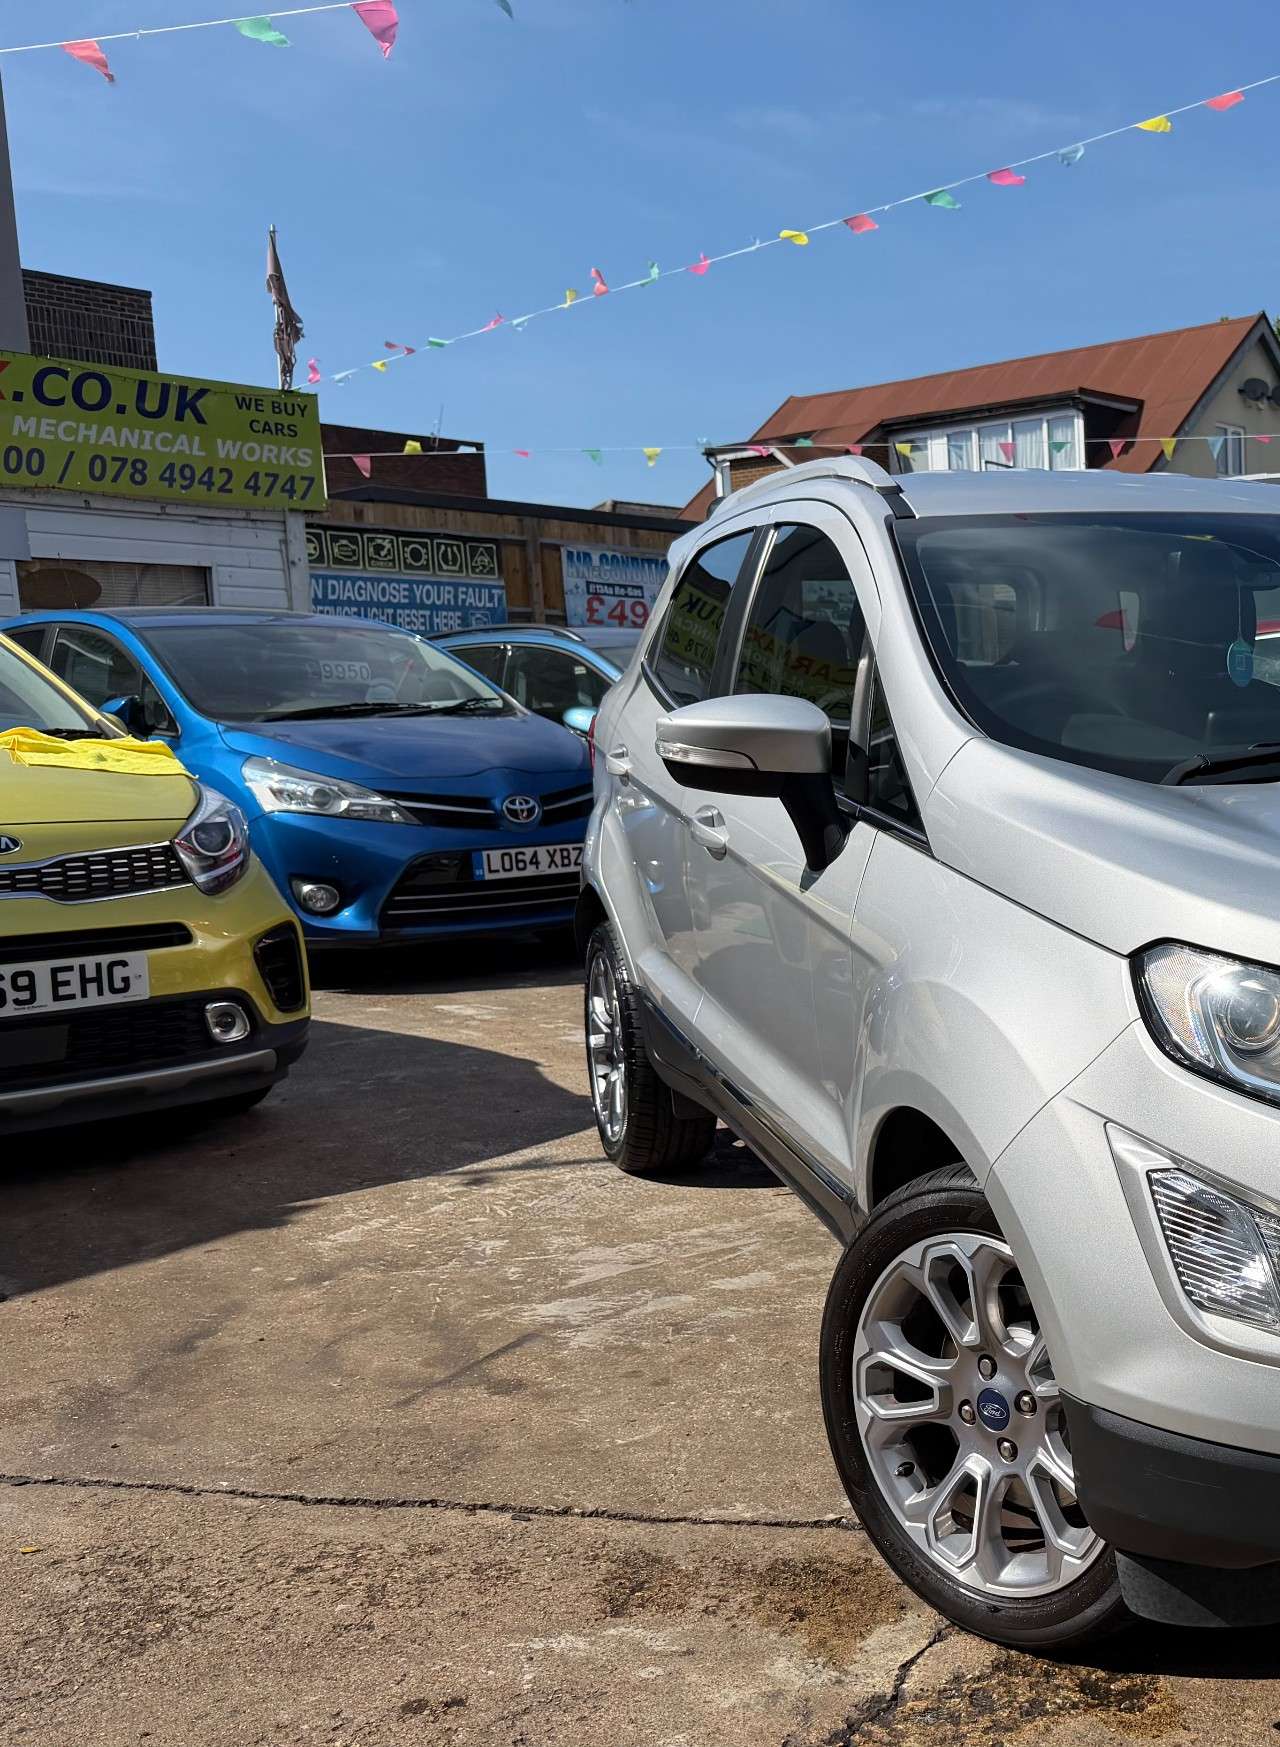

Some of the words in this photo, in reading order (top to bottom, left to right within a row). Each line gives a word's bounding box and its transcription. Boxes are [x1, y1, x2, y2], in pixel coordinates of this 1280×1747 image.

[235, 396, 265, 412] WE
[271, 400, 308, 418] BUY
[249, 419, 298, 438] CARS
[12, 415, 206, 457] MECHANICAL
[216, 439, 313, 467] WORKS
[57, 451, 75, 484] /
[88, 455, 148, 486] 078
[159, 462, 234, 494] 4942
[244, 471, 315, 500] 4747
[327, 580, 409, 604] DIAGNOSE
[413, 584, 454, 605] YOUR
[397, 609, 430, 631] RESET
[433, 611, 462, 631] HERE
[322, 664, 370, 681] 9950
[546, 846, 583, 869] XBZ
[50, 960, 131, 1003] EHG
